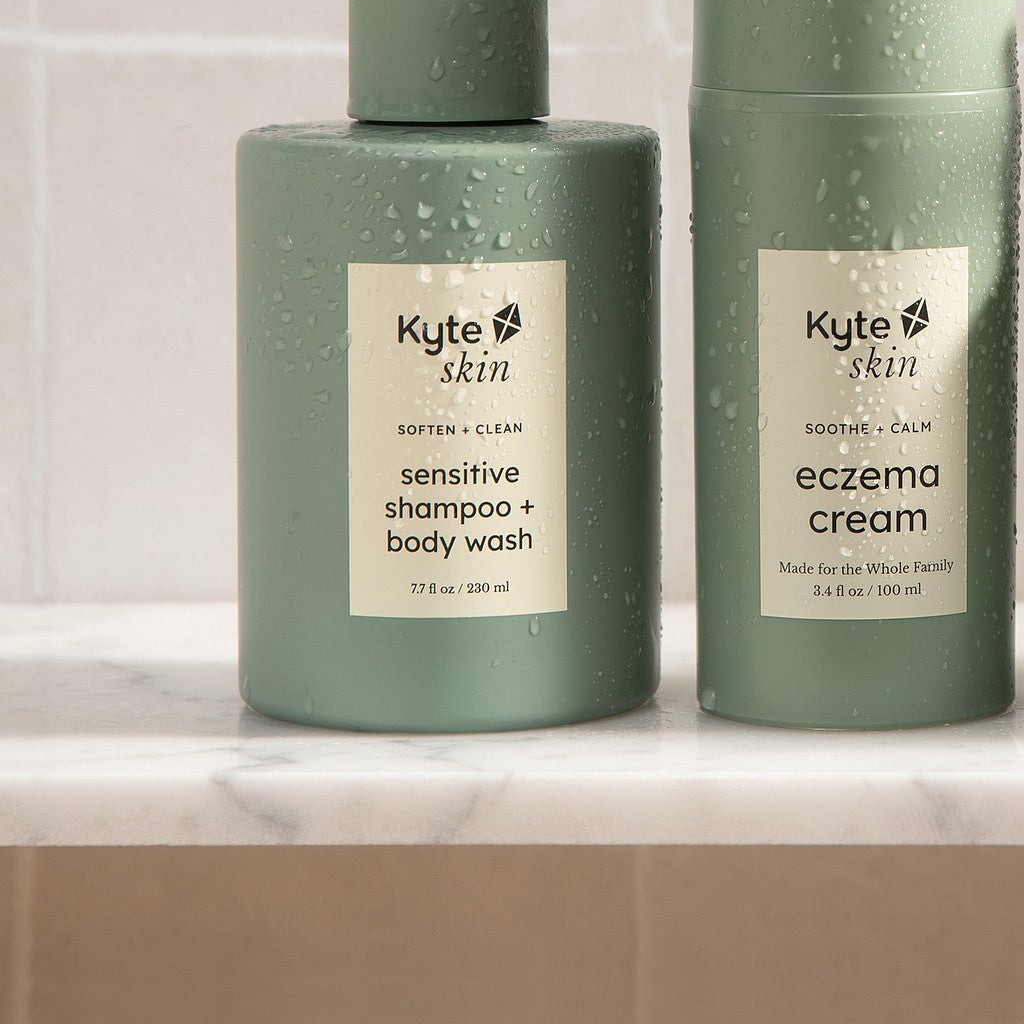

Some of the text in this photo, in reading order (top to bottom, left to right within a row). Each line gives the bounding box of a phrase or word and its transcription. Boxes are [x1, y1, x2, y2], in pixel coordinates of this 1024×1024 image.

[397, 314, 483, 357] Kyte
[806, 310, 891, 352] Kyte
[439, 350, 510, 384] skin
[848, 345, 919, 380] skin
[397, 422, 523, 436] SOFTEN + CLEAN
[805, 420, 932, 435] SOOTHE + CALM
[400, 460, 520, 486] sensitive
[795, 464, 940, 491] eczema
[384, 495, 535, 526] shampoo +
[808, 505, 928, 535] cream
[387, 527, 533, 560] body wash
[779, 558, 955, 576] Made for the Whole Family
[410, 580, 510, 595] 7.7 fl oz / 230 ml
[813, 582, 922, 597] 3.4 fl oz / 100 ml
